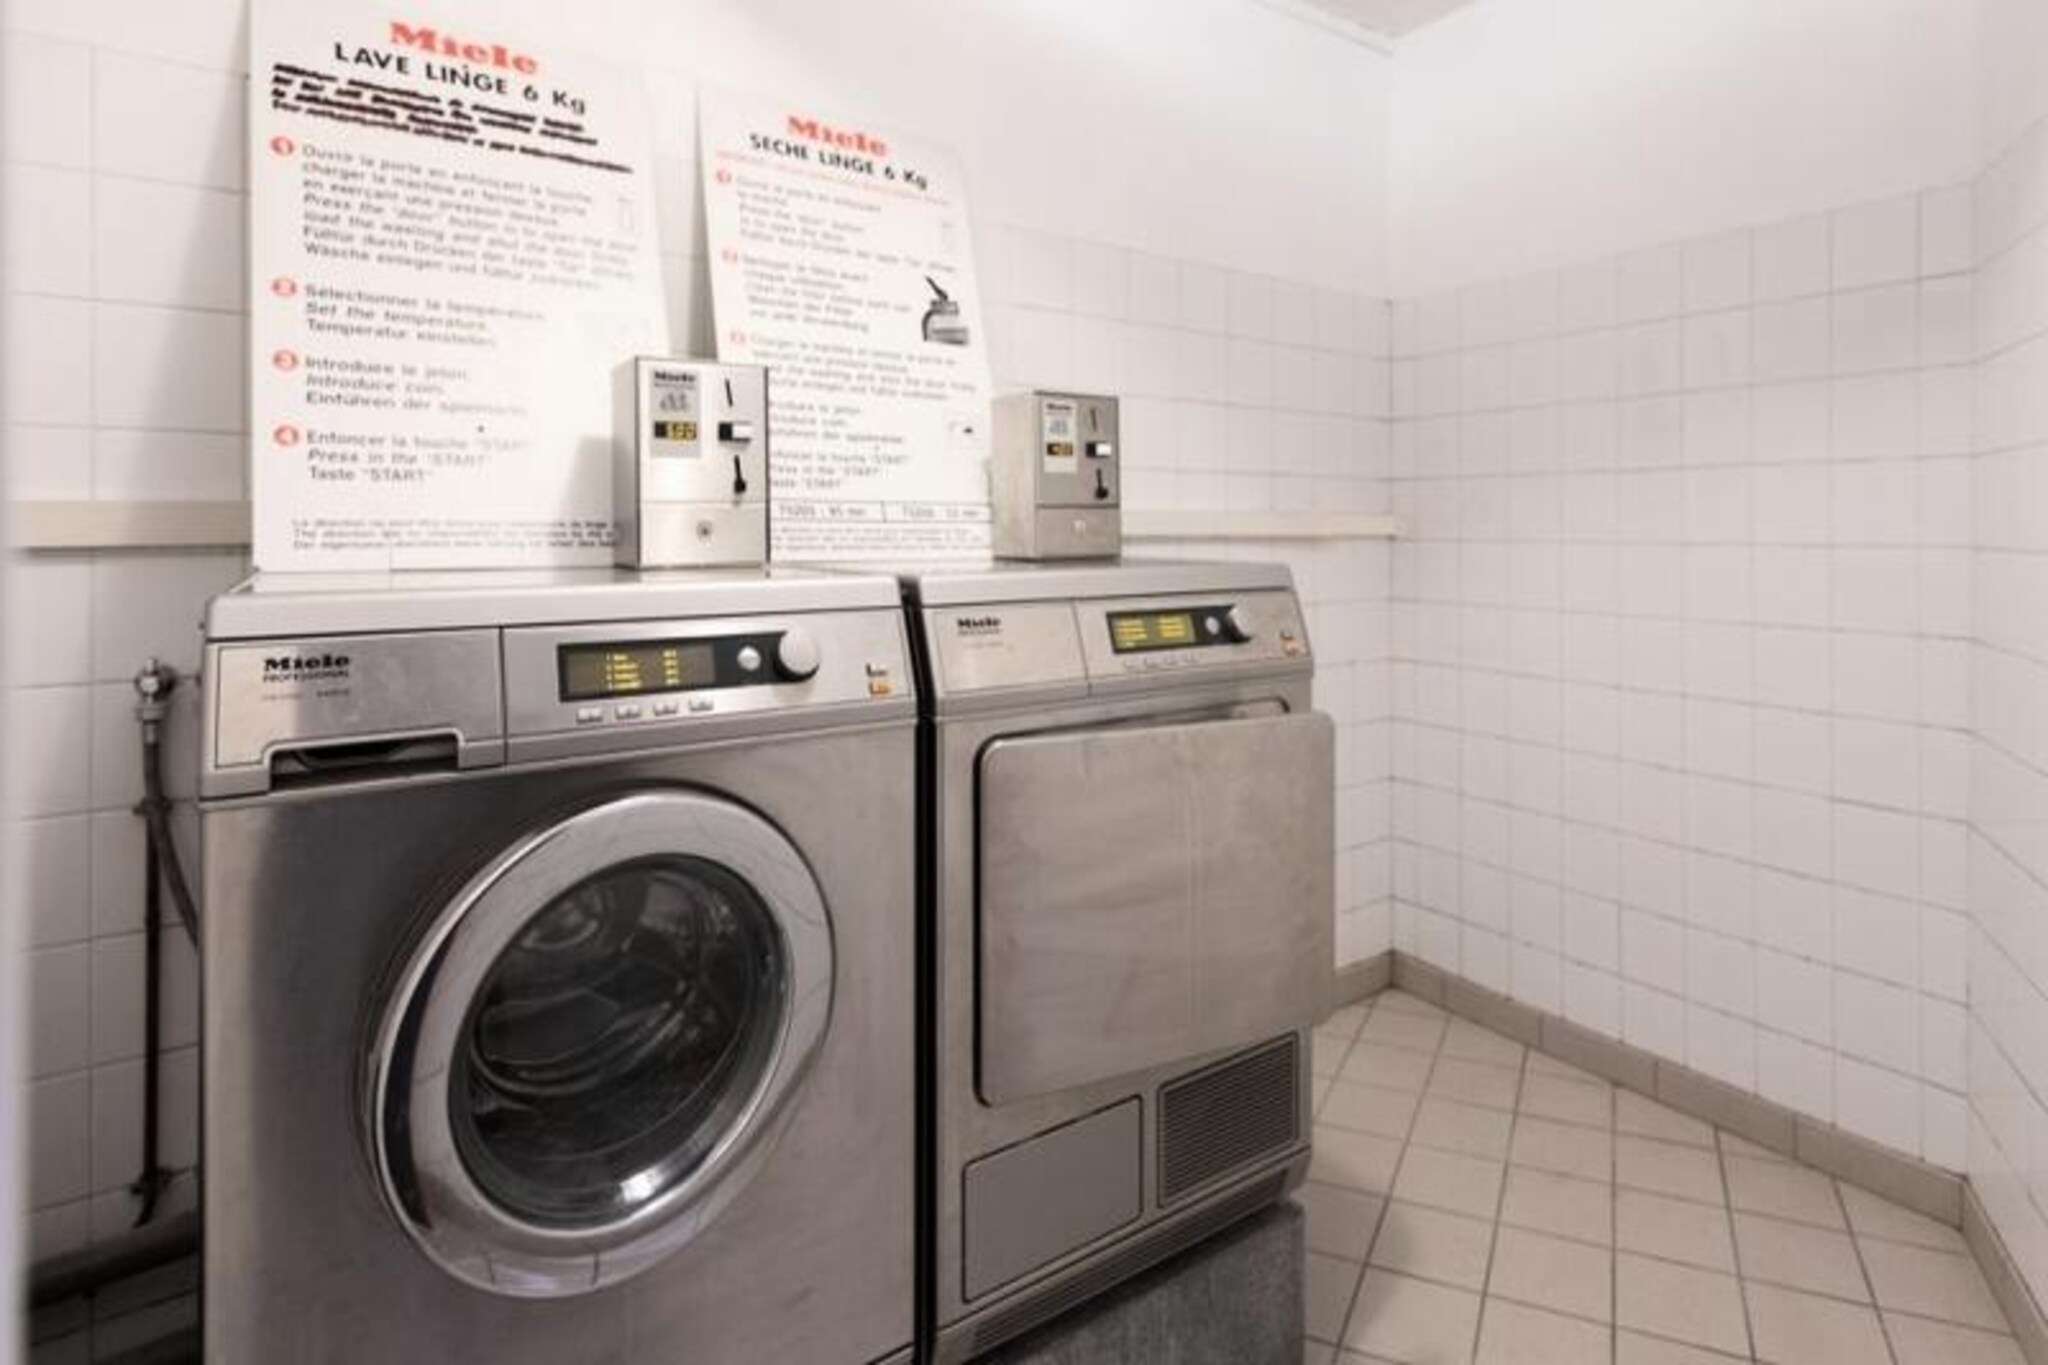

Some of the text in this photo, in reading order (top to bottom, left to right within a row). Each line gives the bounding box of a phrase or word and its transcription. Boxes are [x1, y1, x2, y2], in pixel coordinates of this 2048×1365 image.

[390, 22, 536, 75] Miele
[334, 42, 411, 76] LAVE
[425, 62, 508, 96] LINGE
[523, 84, 539, 103] 6
[552, 90, 586, 116] Kg
[786, 114, 887, 158] Miele
[749, 131, 809, 161] SECHE
[818, 147, 875, 176] LINGE
[902, 168, 929, 192] Kg
[302, 192, 350, 210] Press
[304, 301, 336, 315] Set
[346, 305, 373, 320] the
[306, 317, 405, 337] Temperatur
[306, 446, 357, 463] Press
[308, 464, 354, 480] Taste
[957, 616, 1001, 629] Miele
[264, 653, 350, 671] Miele
